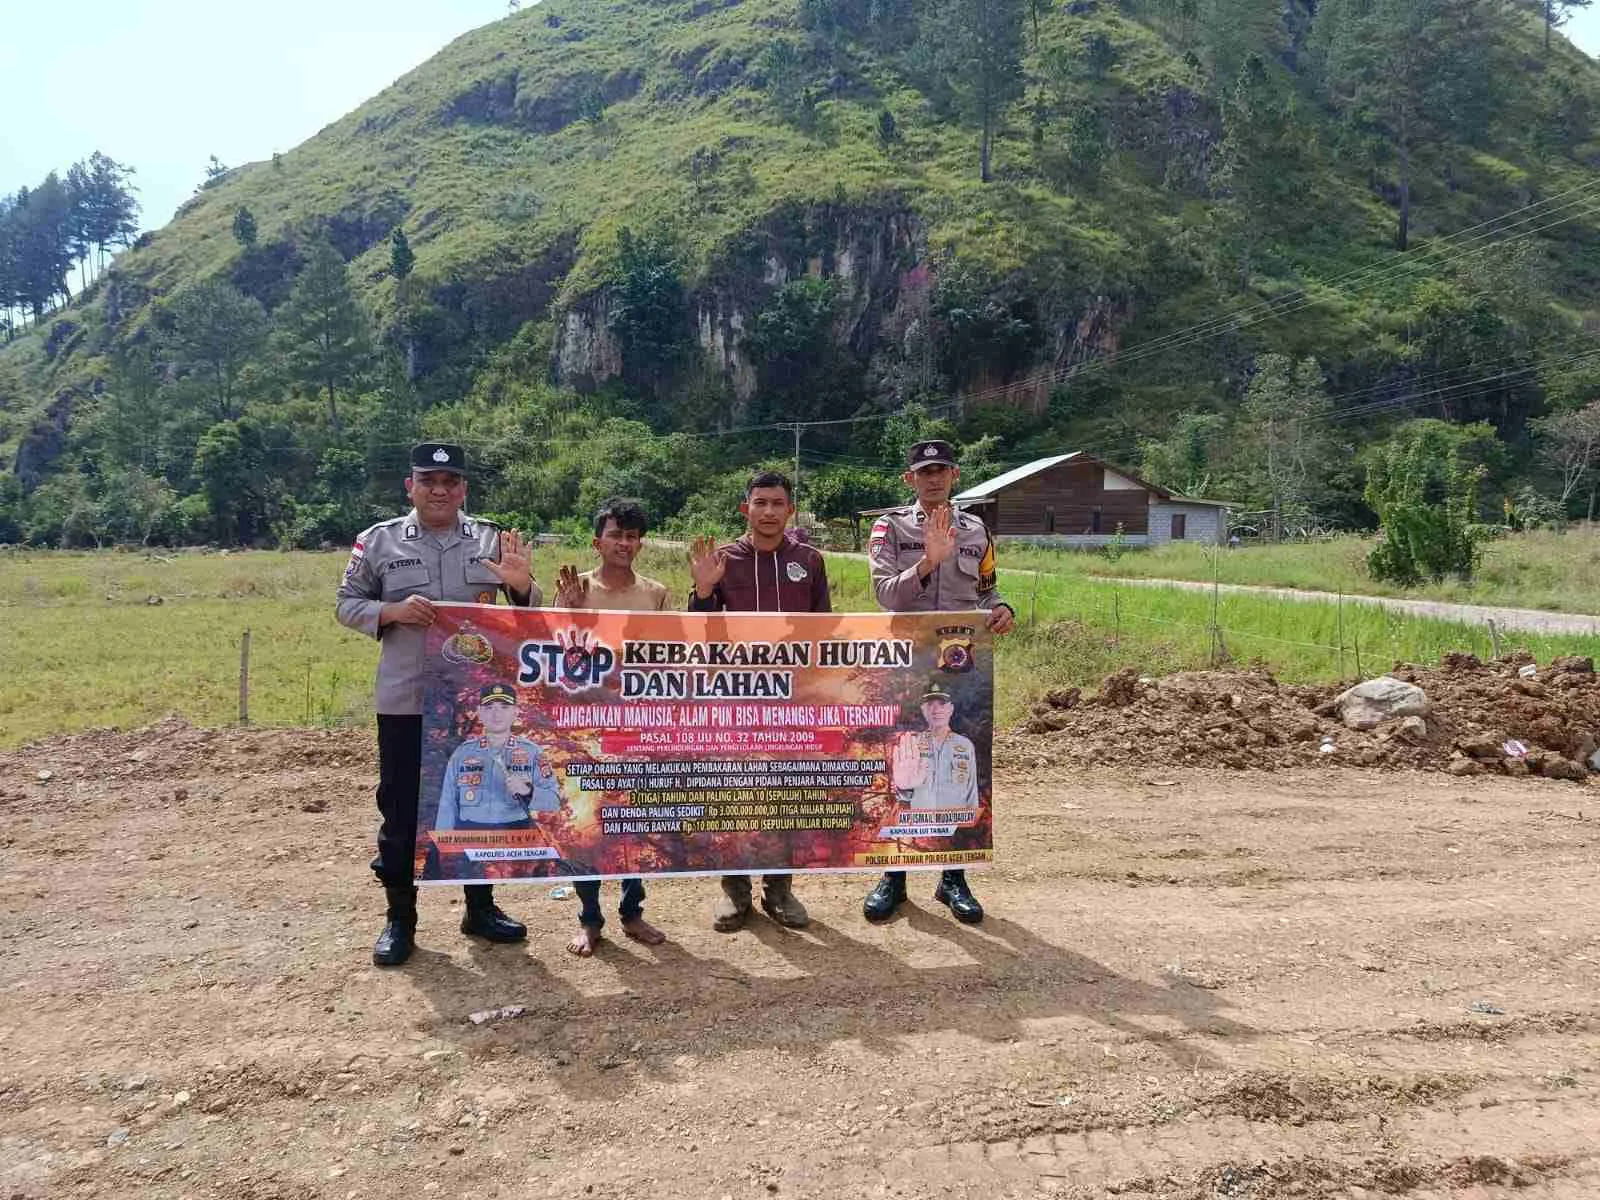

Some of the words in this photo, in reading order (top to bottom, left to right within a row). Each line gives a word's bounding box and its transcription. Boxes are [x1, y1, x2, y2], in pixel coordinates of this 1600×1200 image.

[519, 642, 614, 685] STOP
[623, 642, 809, 666] KEBAKARAN
[818, 641, 913, 666] HUTAN
[622, 672, 686, 697] DAN
[694, 672, 791, 697] LAHAN
[680, 705, 709, 726] ALAM
[711, 705, 733, 726] PUN
[736, 705, 760, 726] BISA
[762, 705, 816, 726] MENANGIS
[818, 705, 841, 726] JIKA
[640, 732, 673, 743] PASAL
[676, 732, 695, 743] 108
[698, 732, 712, 743] UU
[737, 732, 748, 742] 32
[751, 732, 788, 742] TAHUN
[790, 732, 815, 742] 2009
[567, 764, 593, 775] SETIAP
[594, 764, 621, 775] ORANG
[623, 763, 644, 774] YANG
[646, 763, 691, 774] MELAKUKAN
[693, 763, 742, 774] PEMBAKARAN
[743, 762, 768, 773] LAHAN
[769, 762, 821, 773] SEBAGAIMANA
[822, 761, 859, 772] DIMAKSUD
[861, 761, 886, 772] DALAM
[581, 778, 604, 789] PASAL
[617, 778, 636, 789] AYAT
[649, 777, 673, 788] HURUF
[686, 777, 721, 788] DIPIDANA
[723, 777, 753, 788] DENGAN
[755, 776, 781, 787] PIDANA
[783, 776, 814, 787] PENJARA
[816, 776, 841, 787] PALING
[843, 776, 872, 787] SINGKAT
[662, 792, 687, 803] TAHUN
[688, 792, 704, 803] DAN
[706, 791, 732, 802] PALING
[733, 791, 755, 802] LAMA
[756, 791, 765, 802] 10
[804, 790, 827, 801] TAHUN
[601, 807, 619, 818] DAN
[620, 807, 647, 818] DENDA
[648, 807, 675, 818] PALING
[677, 806, 705, 817] SEDIKIT
[800, 804, 824, 815] MILIAR
[604, 822, 621, 833] DAN
[622, 822, 649, 833] PALING
[651, 821, 681, 832] BANYAK
[796, 819, 821, 830] MILIAR
